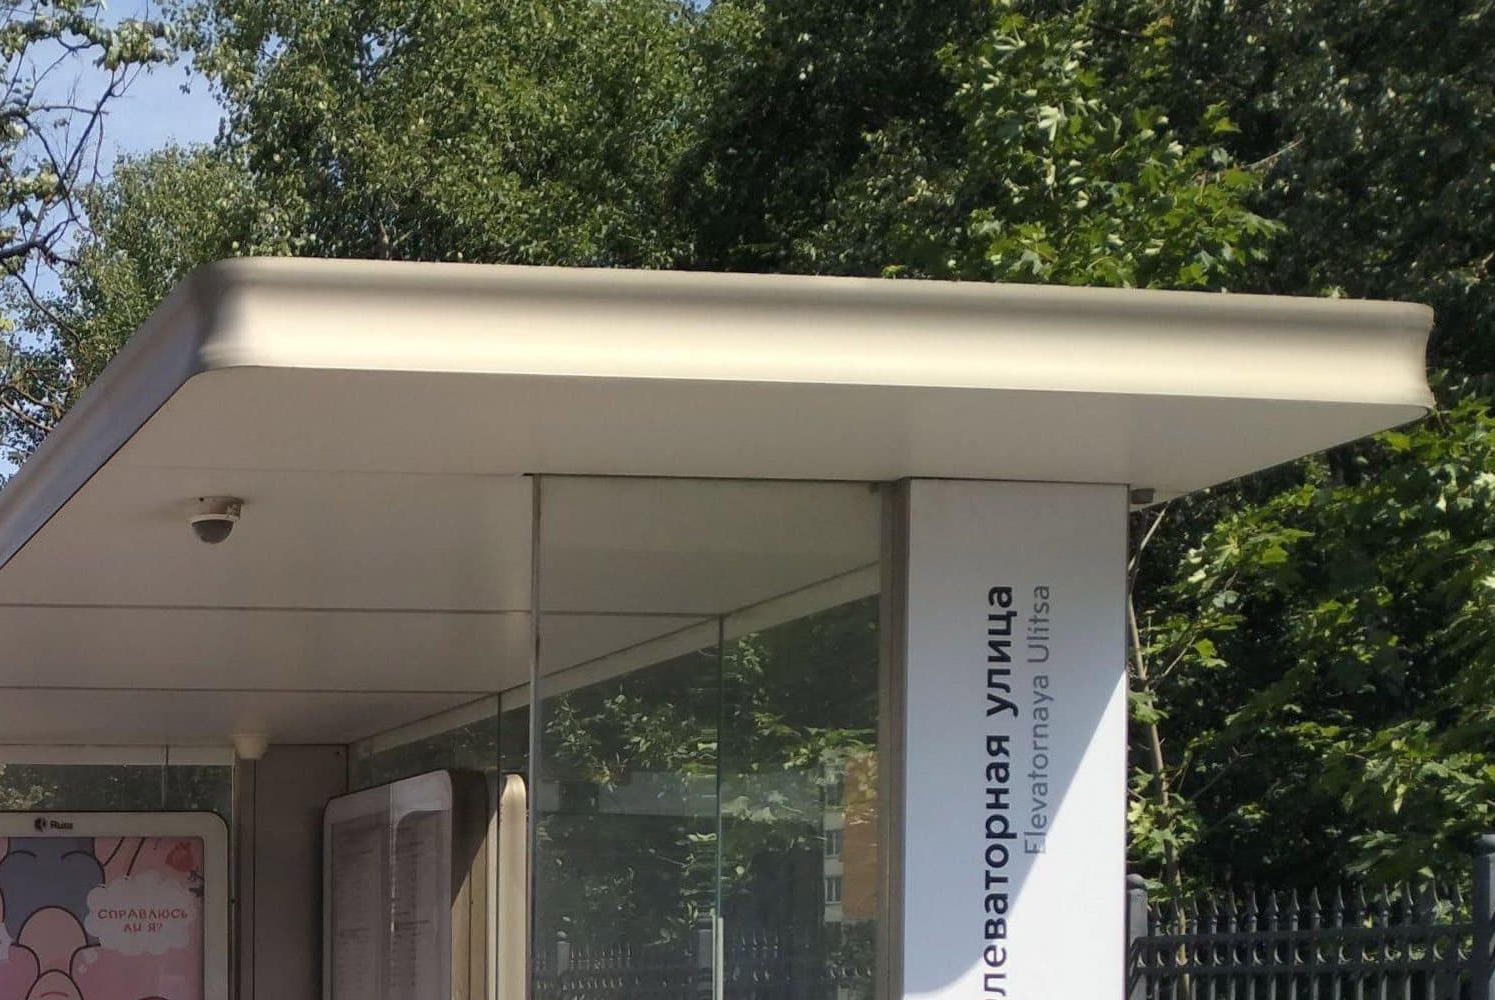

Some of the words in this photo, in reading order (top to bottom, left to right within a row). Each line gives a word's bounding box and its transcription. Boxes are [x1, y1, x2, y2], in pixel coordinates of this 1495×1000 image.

[985, 586, 1019, 717] улица
[1027, 585, 1050, 664] Ulitsa
[1024, 675, 1055, 855] Elevatornaya
[97, 907, 188, 921] СПРАВЛЮСЬ
[148, 922, 164, 934] Я?
